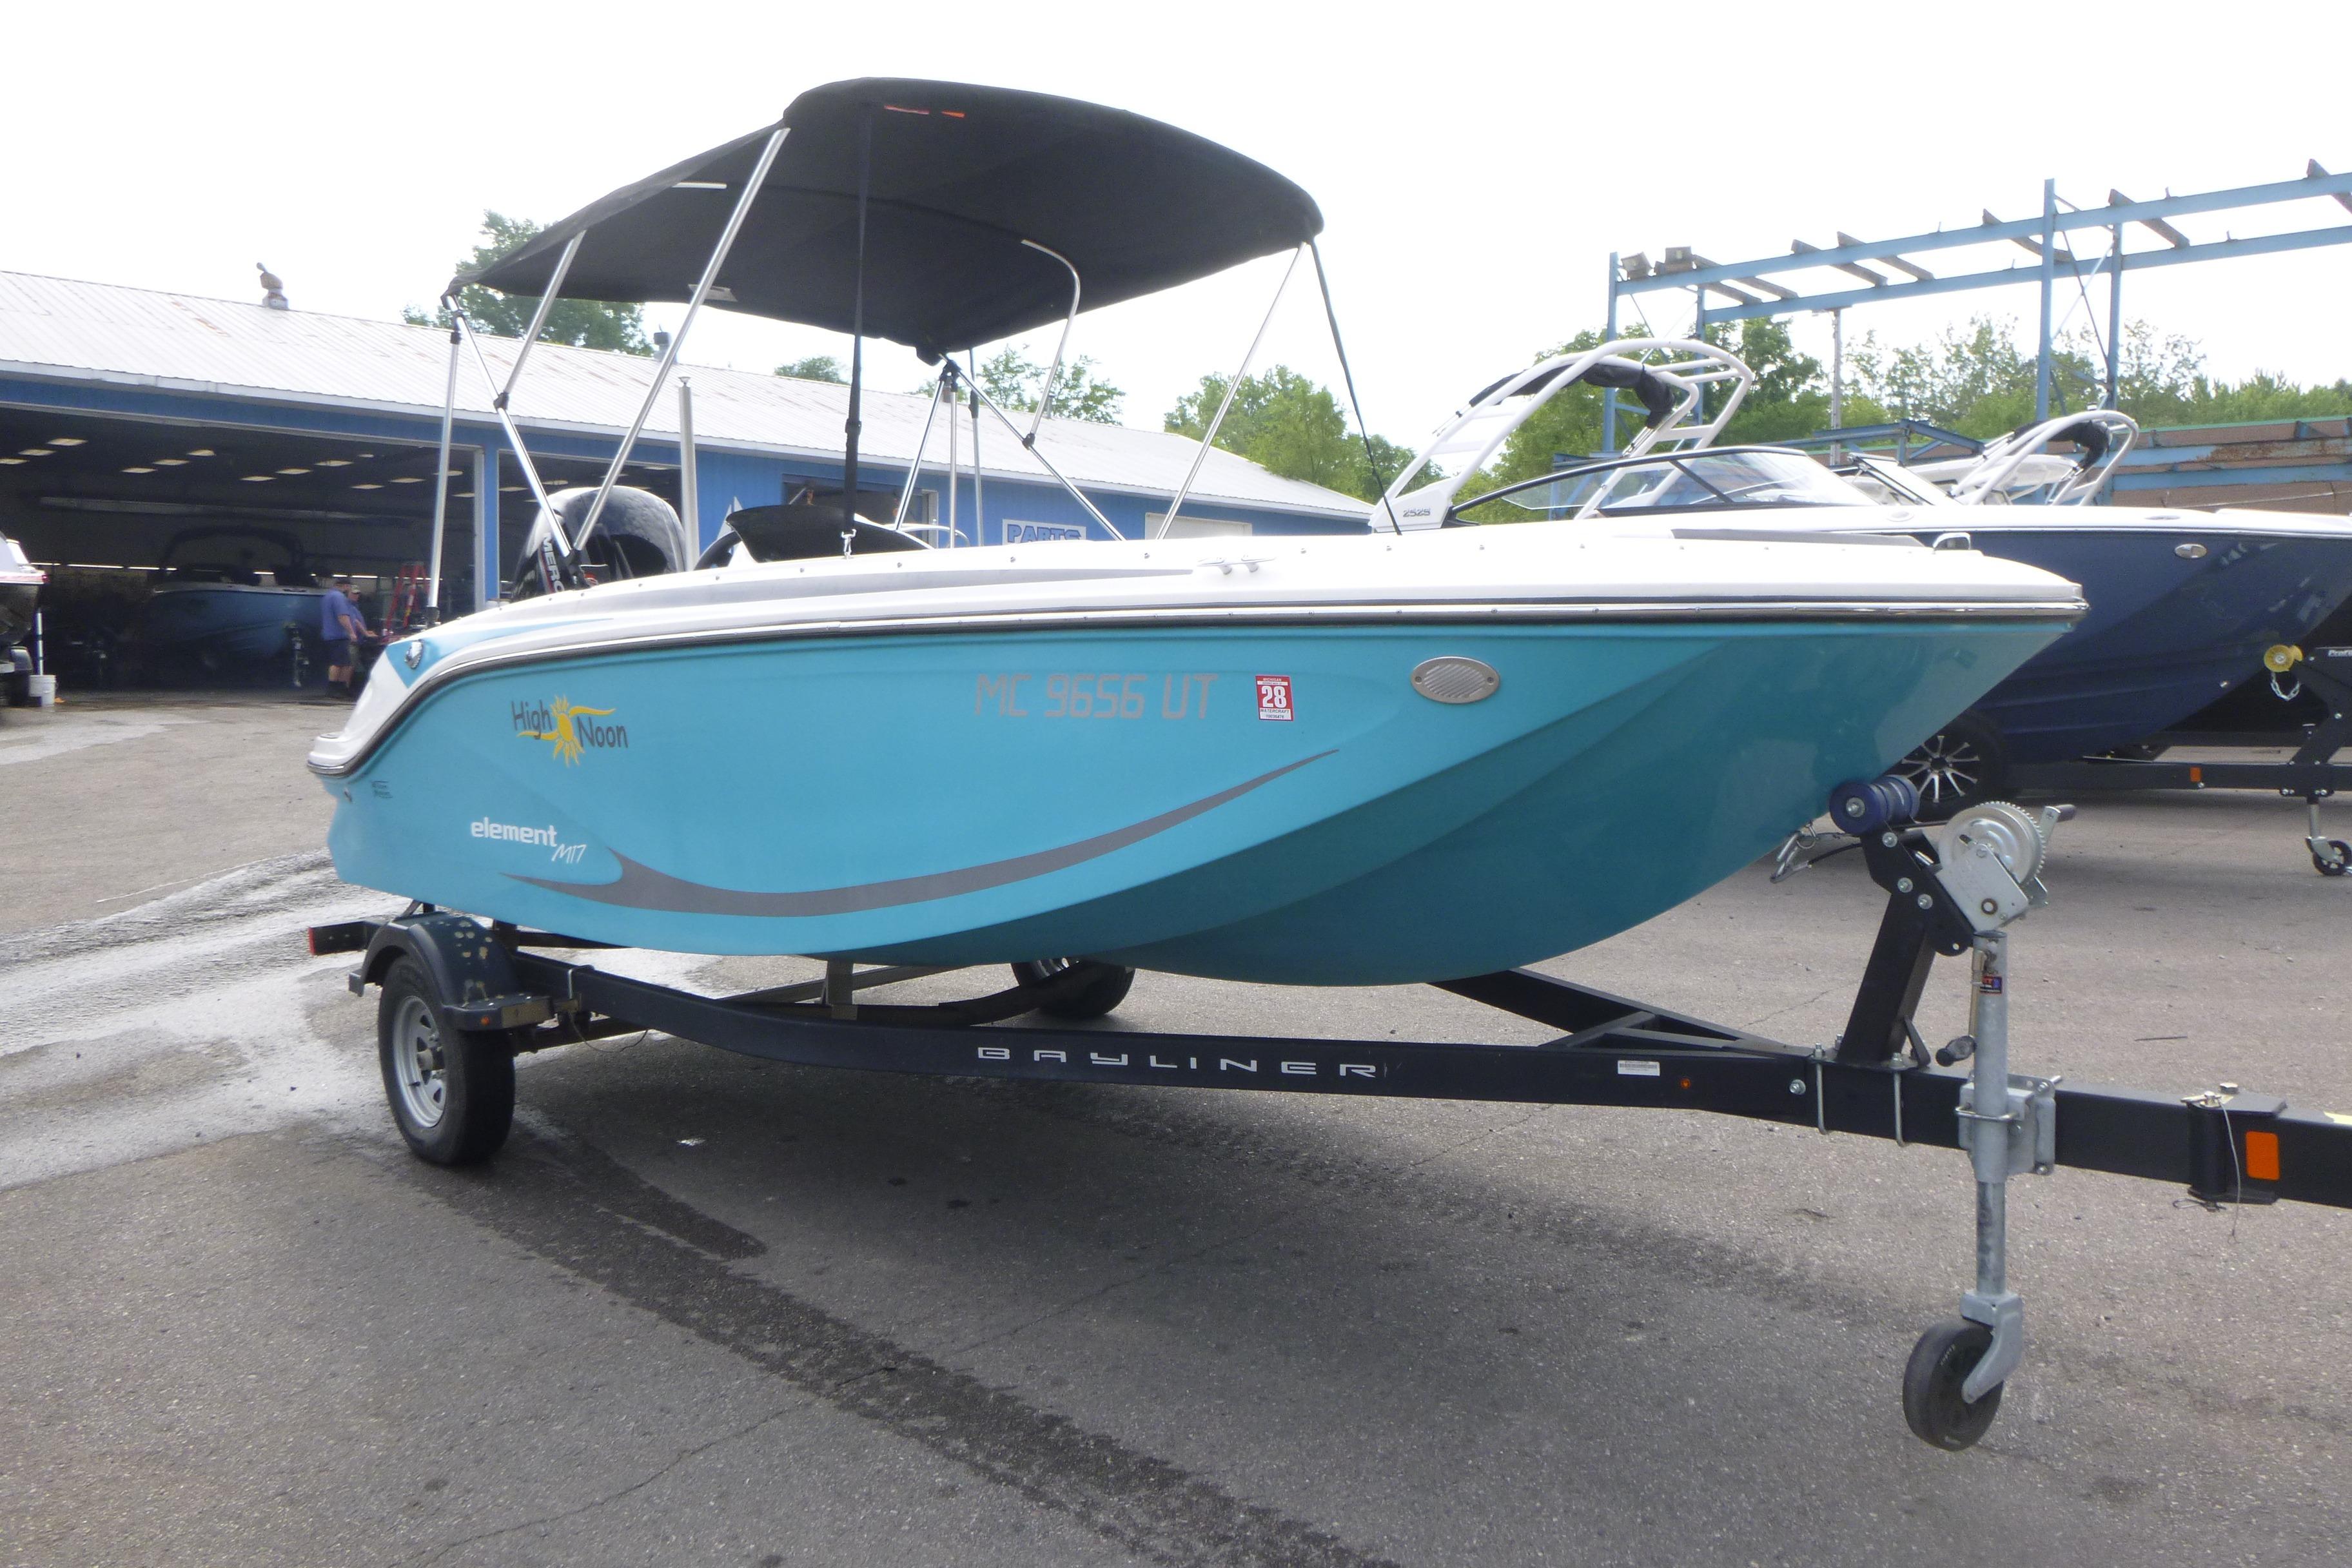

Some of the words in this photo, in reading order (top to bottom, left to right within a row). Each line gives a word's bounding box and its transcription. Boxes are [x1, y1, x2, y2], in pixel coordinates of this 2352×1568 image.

[975, 673, 1031, 717] MC
[1044, 673, 1148, 719] 9656
[1162, 673, 1219, 720] UT
[1261, 685, 1287, 708] 28
[511, 699, 553, 740] High
[577, 716, 629, 749] Noon
[471, 817, 558, 847] element
[977, 1046, 1377, 1078] BAYLINER
